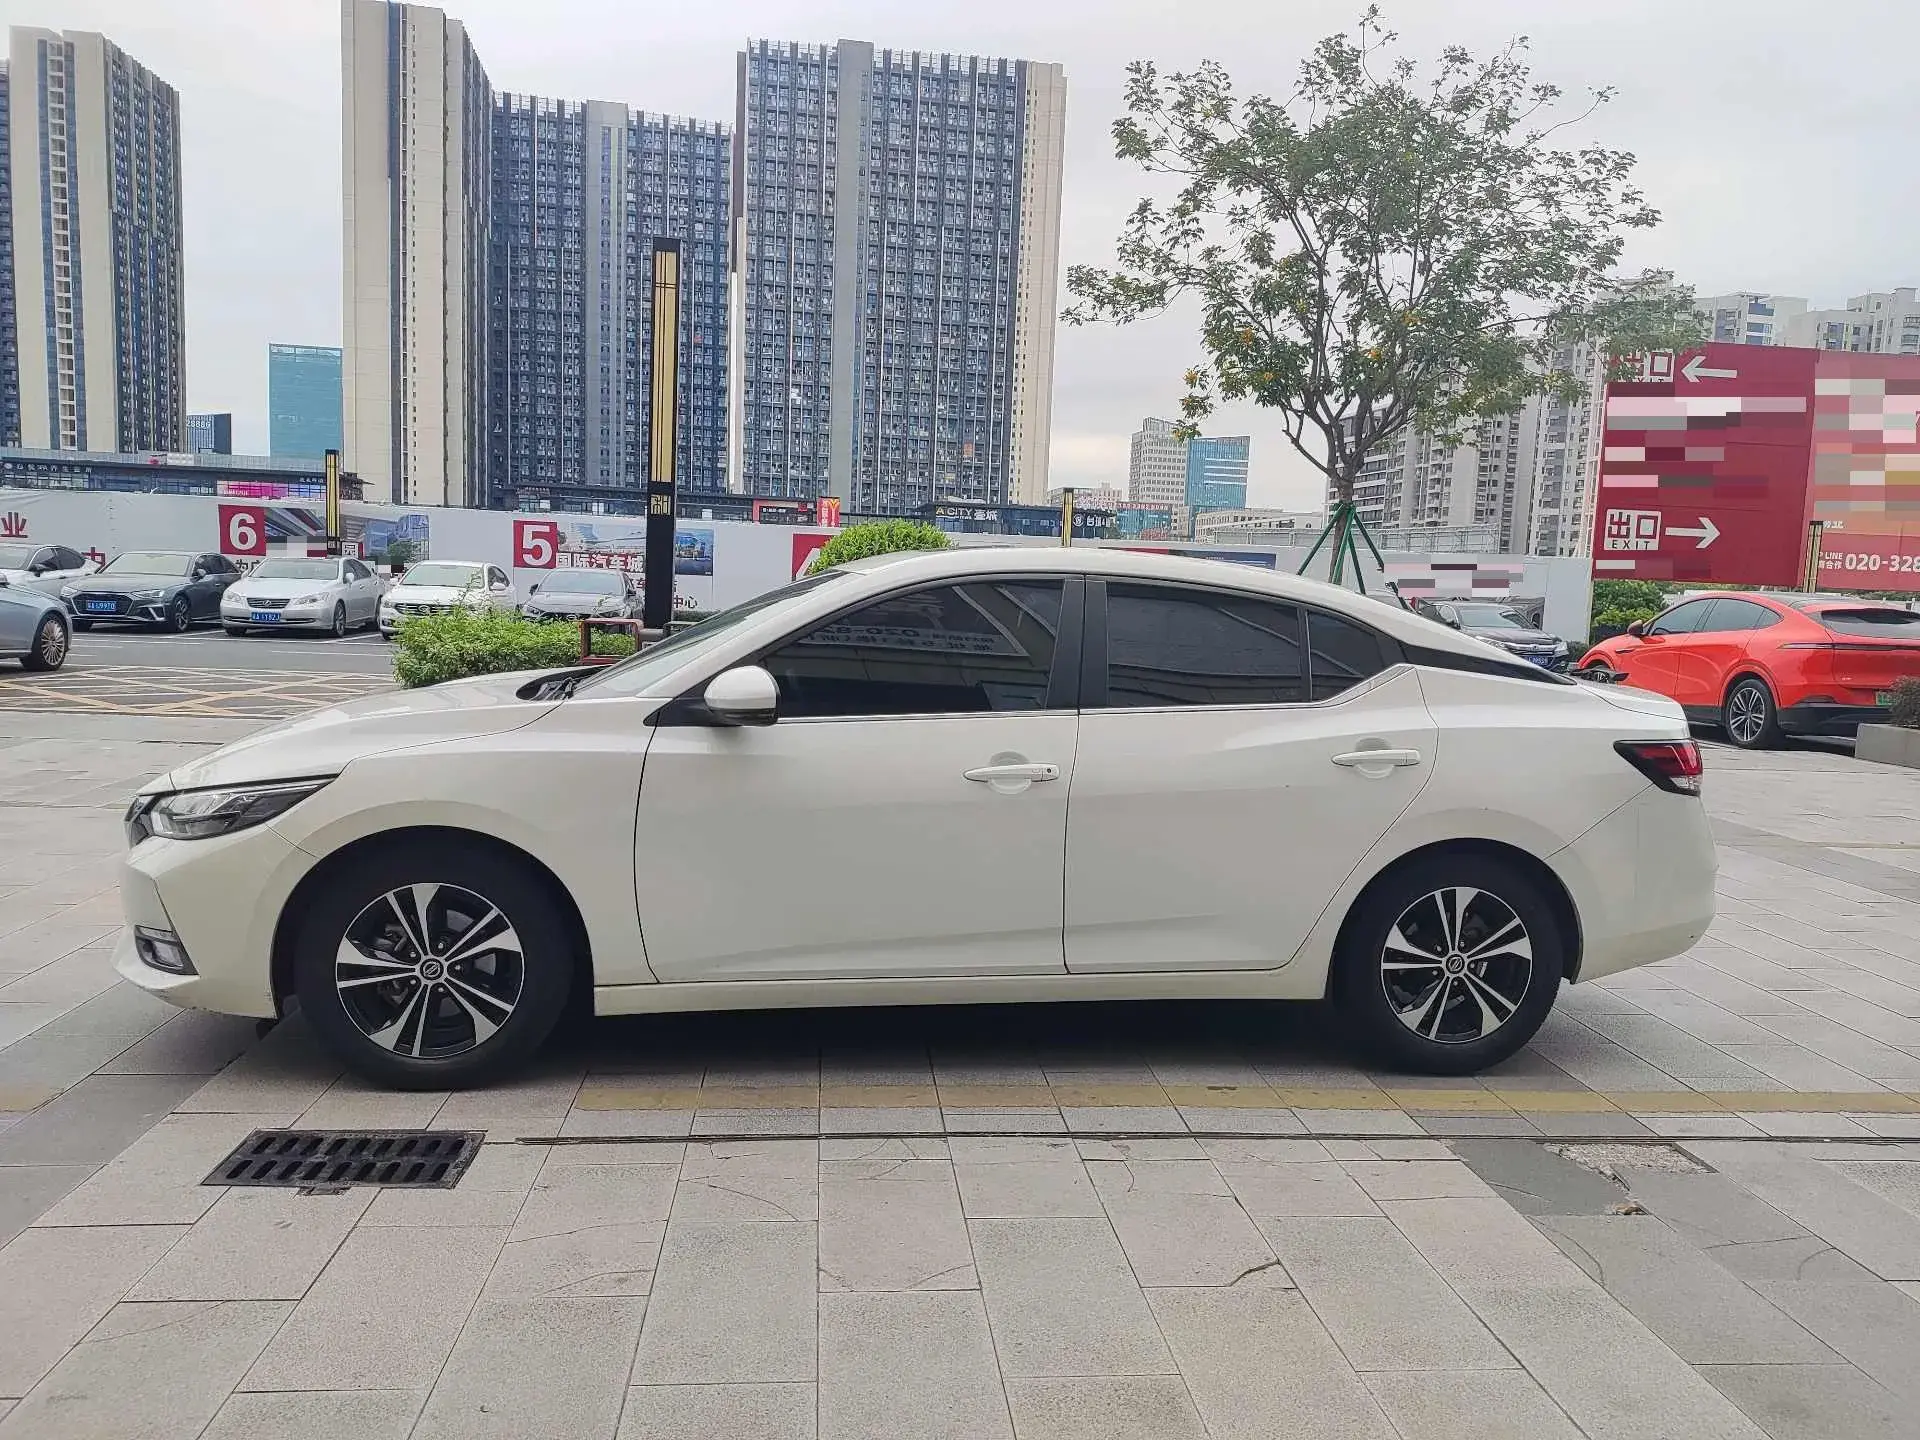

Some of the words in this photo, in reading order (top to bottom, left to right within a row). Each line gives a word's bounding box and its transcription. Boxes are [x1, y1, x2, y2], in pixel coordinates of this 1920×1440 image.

[229, 513, 257, 550] 6
[1607, 511, 1659, 539] 出口
[522, 524, 553, 566] 5
[1611, 540, 1651, 550] EXIT
[556, 553, 645, 573] 国际汽车城
